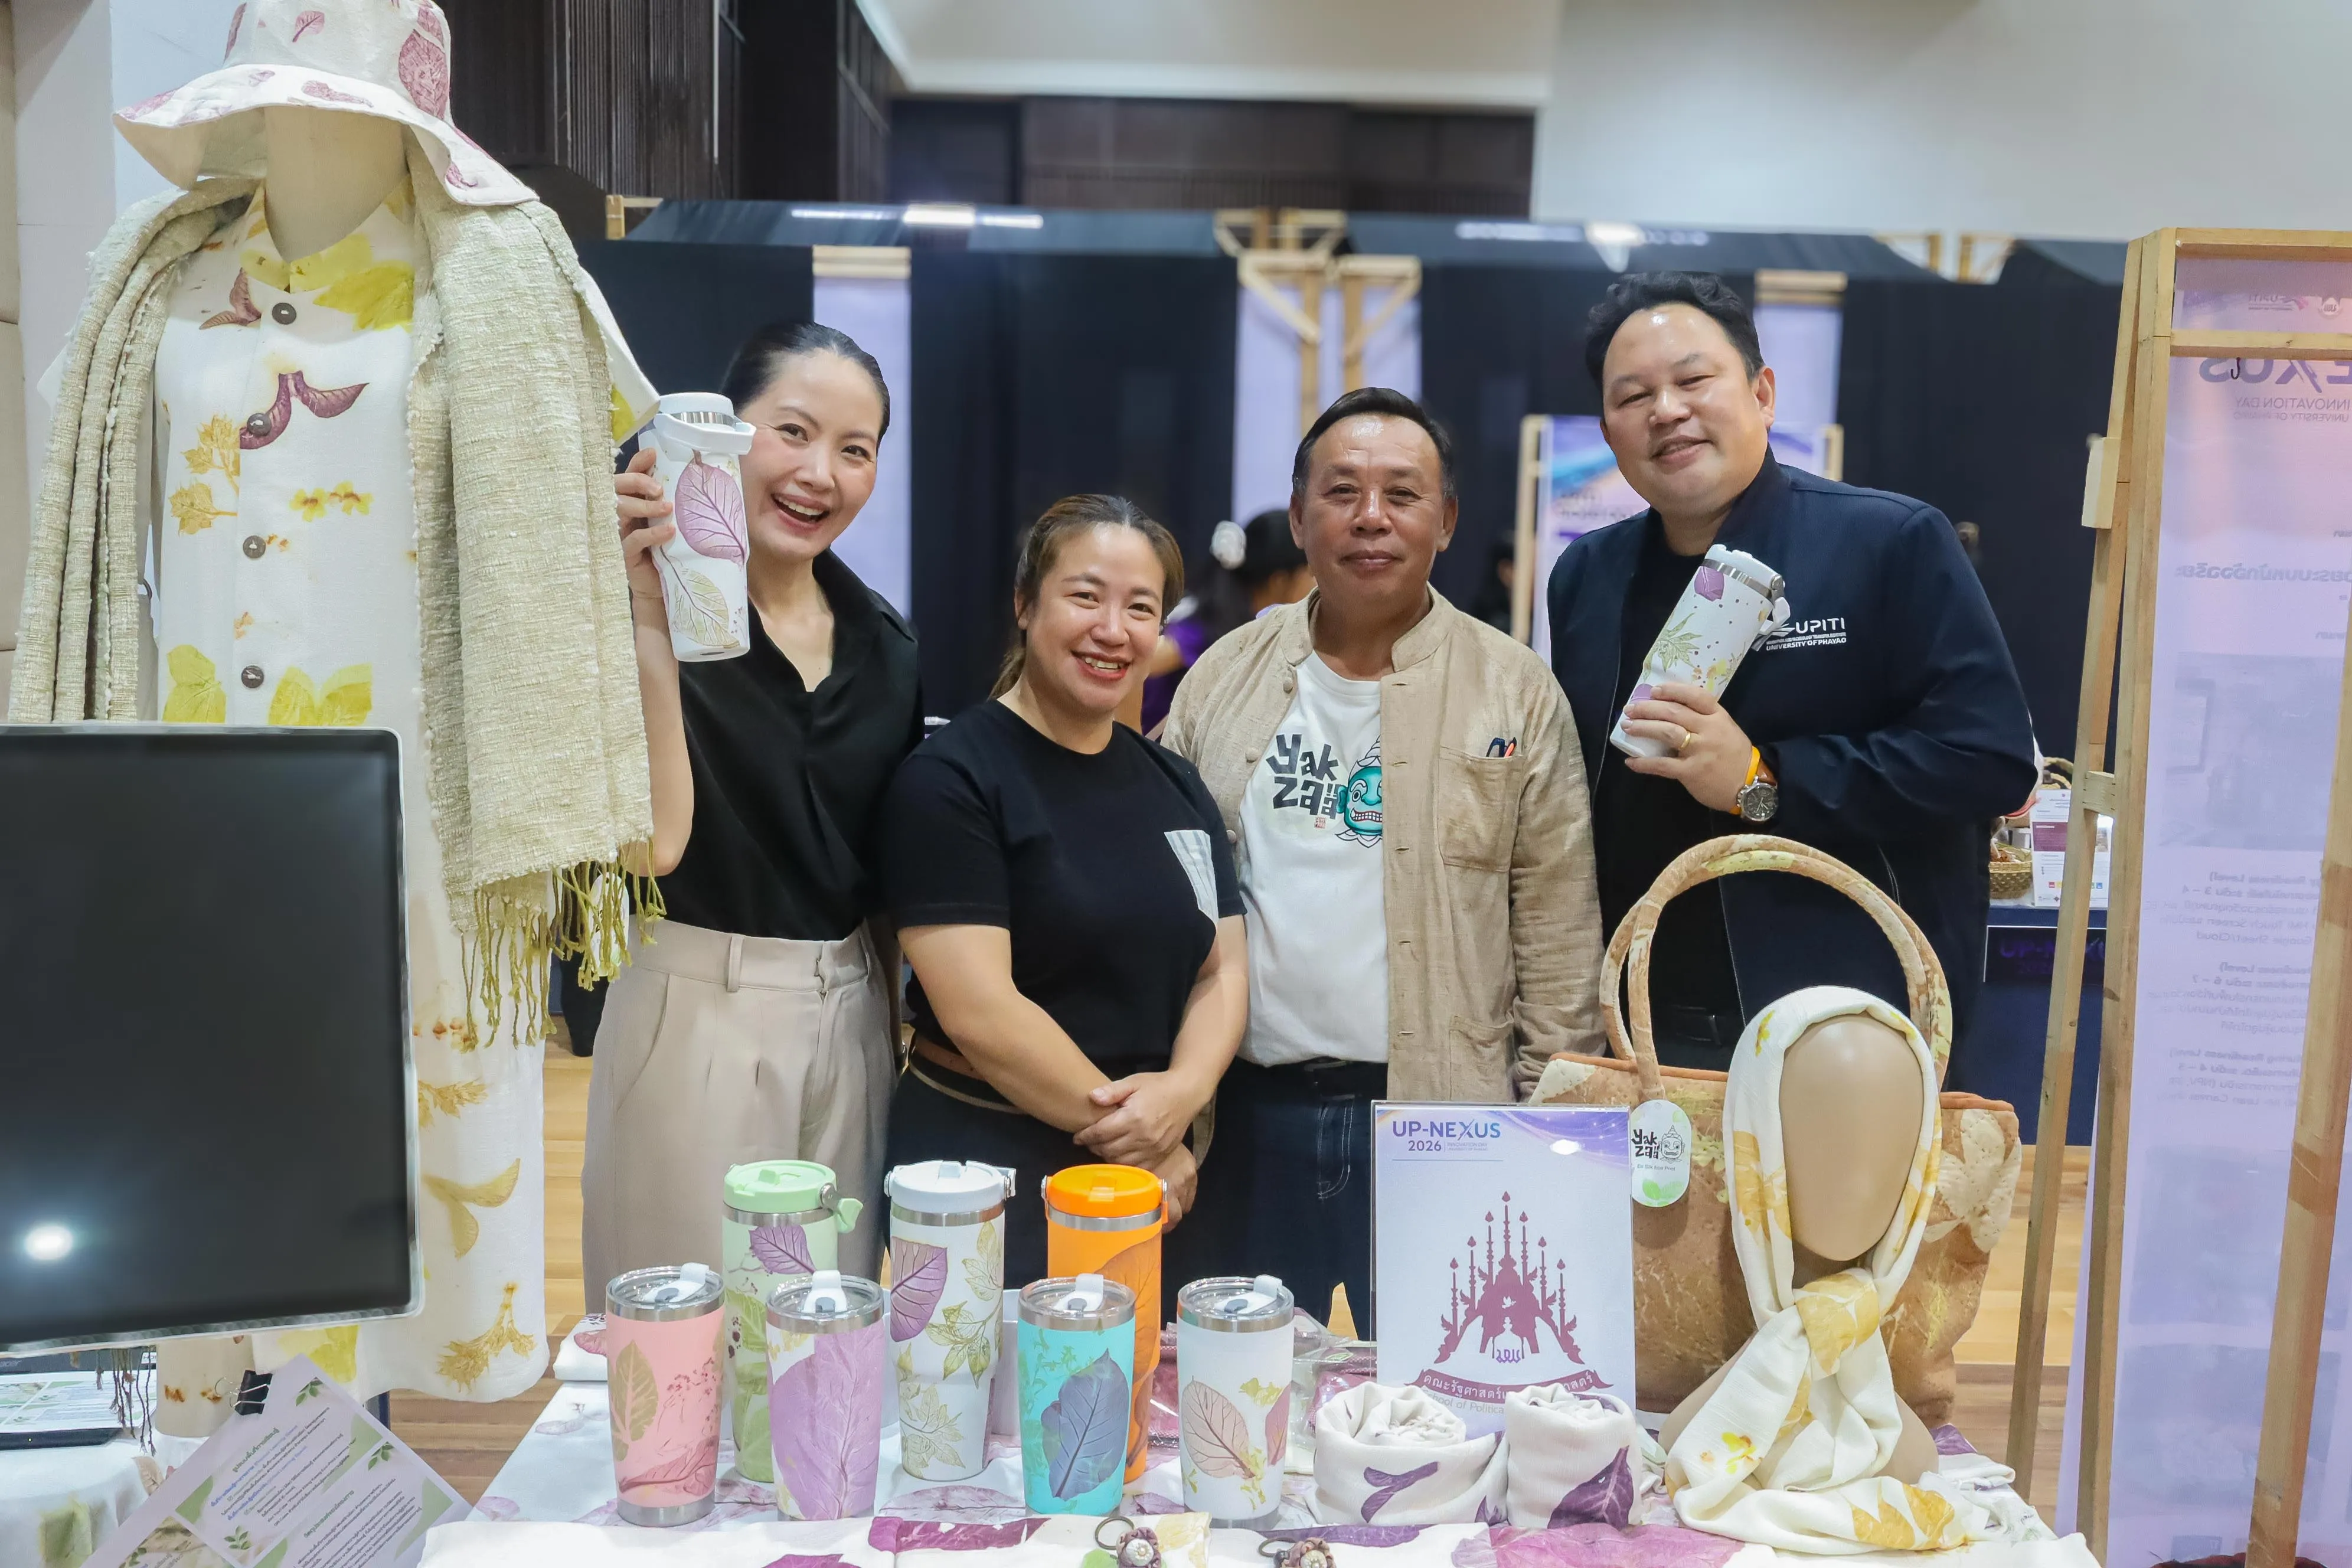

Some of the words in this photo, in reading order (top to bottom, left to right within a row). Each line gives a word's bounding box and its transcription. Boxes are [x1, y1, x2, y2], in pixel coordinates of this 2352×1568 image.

[1795, 618, 1845, 634] UPITI
[1766, 641, 1807, 651] UNIVERSITY
[1393, 1119, 1501, 1141] UP-NEXUS
[1408, 1140, 1442, 1151] 2026
[1456, 1400, 1466, 1409] of
[1470, 1402, 1504, 1414] Politica
